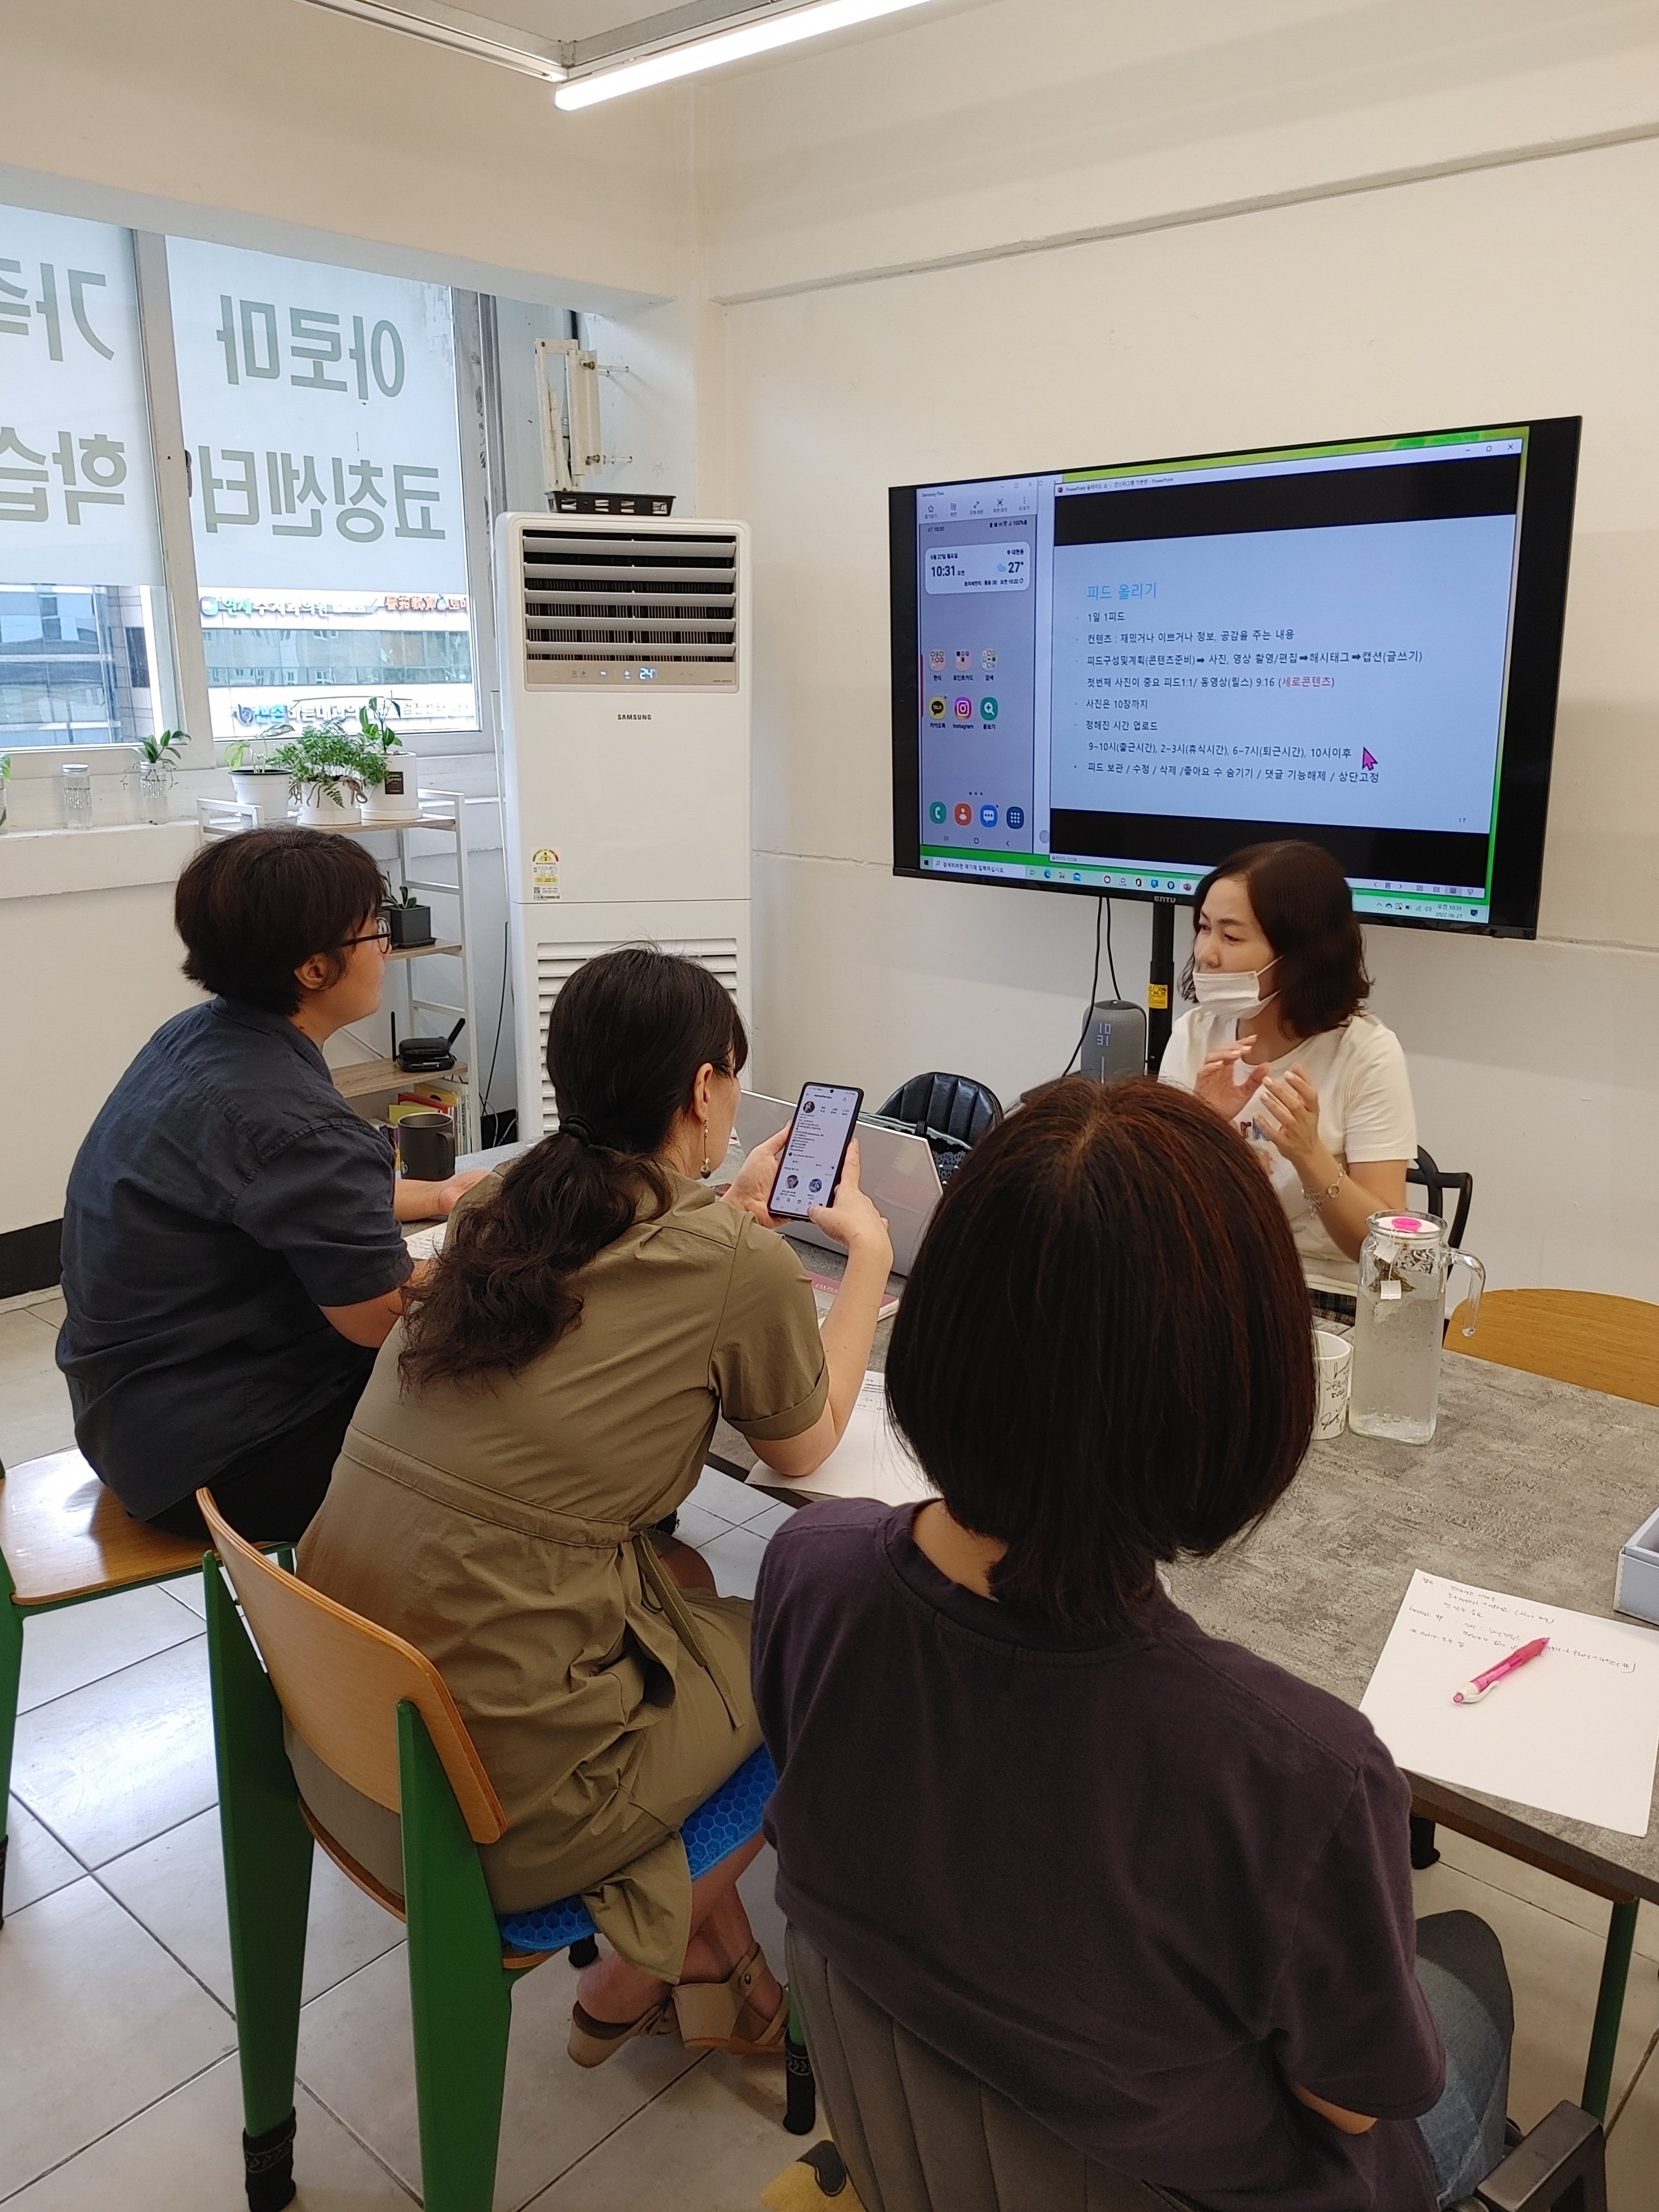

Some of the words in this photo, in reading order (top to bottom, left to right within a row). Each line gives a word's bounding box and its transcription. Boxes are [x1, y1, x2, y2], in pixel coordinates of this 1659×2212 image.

[931, 565, 955, 577] 10:31
[1087, 585, 1112, 601] 피드
[1118, 582, 1157, 600] 올리기
[1088, 612, 1100, 622] 1일
[1104, 612, 1125, 622] 1피드
[1087, 634, 1112, 644] 컨텐츠
[1120, 633, 1154, 644] 재밌거나
[1158, 632, 1193, 643] 이쁘거나
[1220, 630, 1248, 641] 공감을
[1253, 630, 1271, 640] 주는
[1276, 629, 1295, 640] 내용
[1234, 654, 1251, 665] 영상
[1310, 652, 1349, 663] 해시태그
[1362, 651, 1422, 663] 캡션(글쓰기)
[1087, 677, 1112, 687] 첫번째
[1115, 677, 1140, 687] 사진이
[1143, 677, 1160, 687] 중요
[1201, 677, 1253, 688] 동영상(릴스)
[1256, 677, 1275, 687] 9:16
[1279, 676, 1334, 688] (세로콘텐츠)
[1086, 700, 1110, 709] 사진은
[1114, 700, 1148, 709] 10장까지
[1086, 721, 1109, 731] 정해진
[1113, 721, 1129, 731] 시간
[1134, 721, 1158, 731] 업로드
[1311, 747, 1351, 759] 10시이후
[1088, 763, 1103, 772] 피드
[1108, 764, 1123, 773] 보관
[1133, 764, 1149, 774] 수정
[1160, 765, 1176, 775] 삭제
[1214, 768, 1222, 777] 수
[1226, 768, 1253, 779] 숨기기
[1265, 769, 1283, 780] 댓글
[1288, 770, 1326, 781] 기능해제
[1338, 772, 1379, 783] 상단고정
